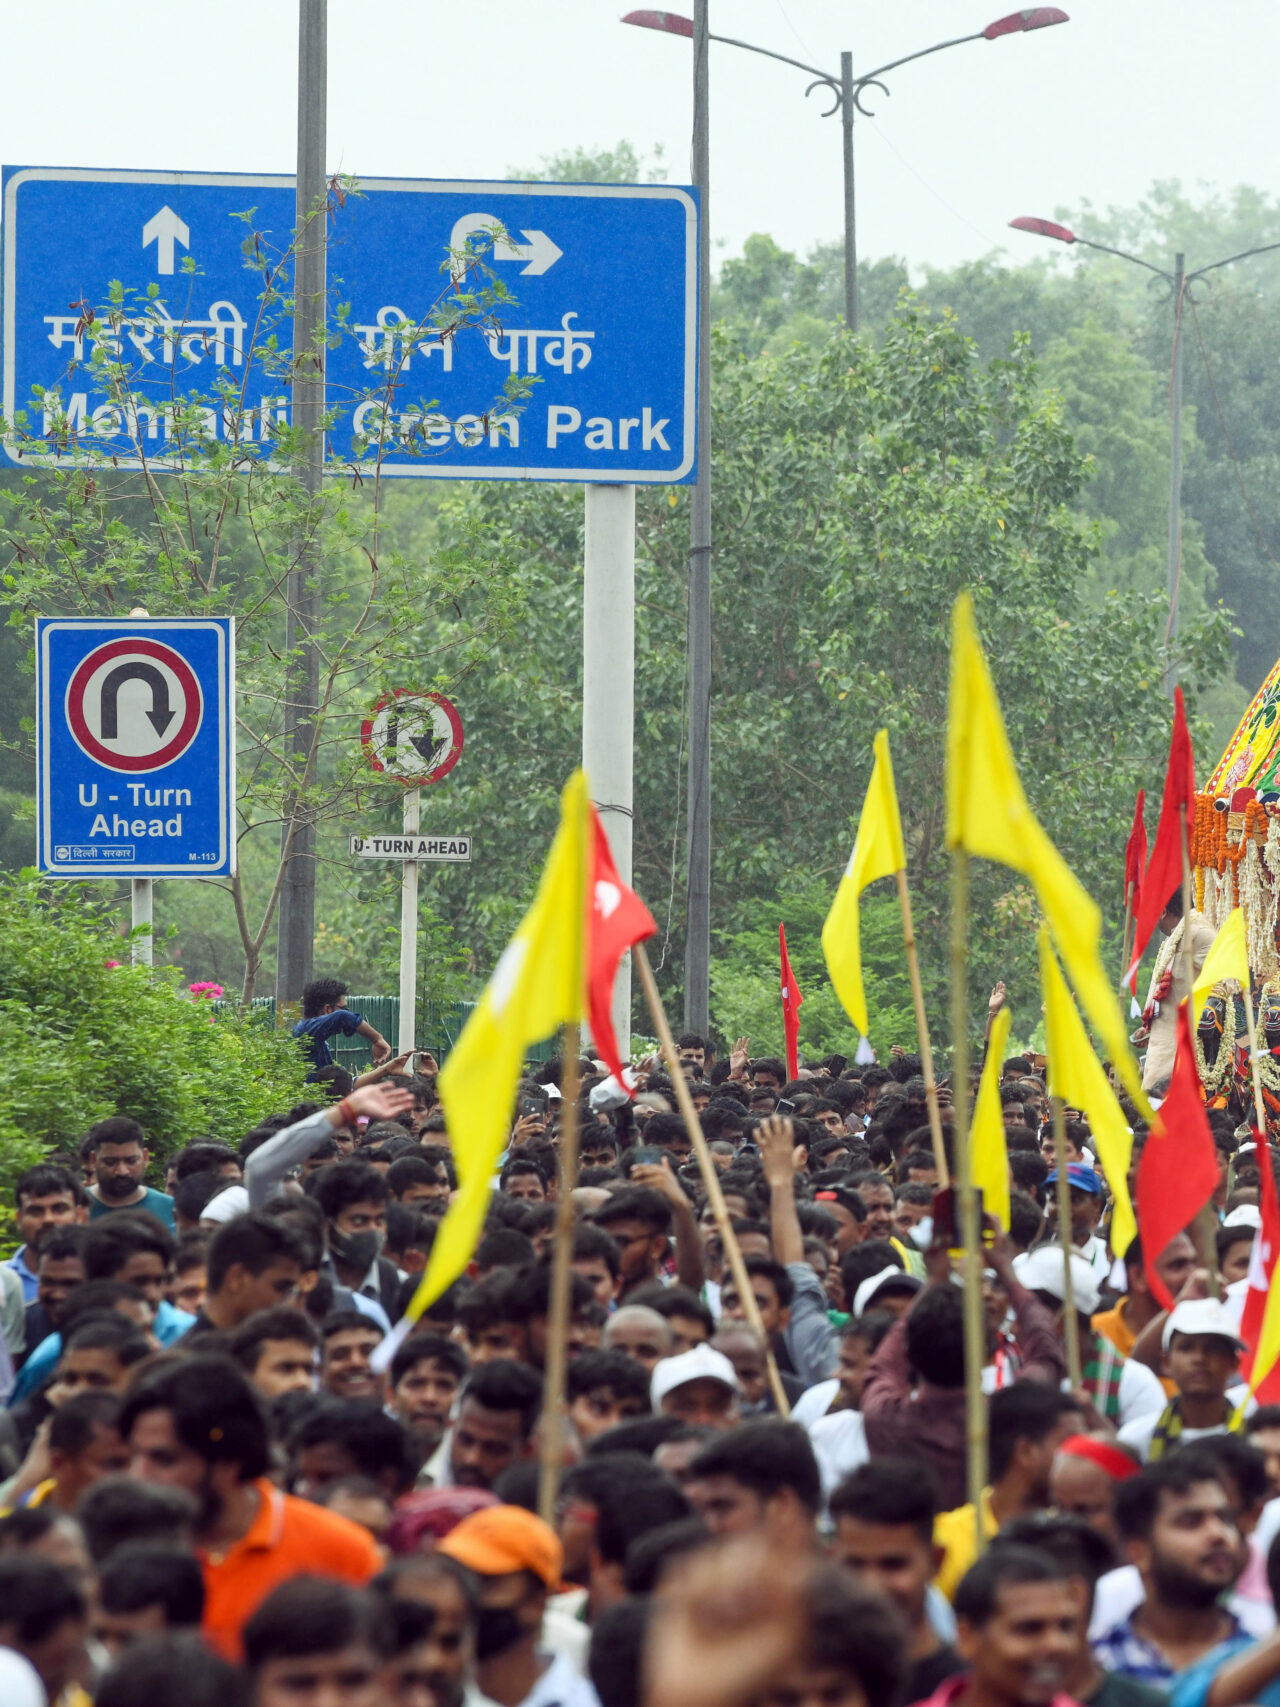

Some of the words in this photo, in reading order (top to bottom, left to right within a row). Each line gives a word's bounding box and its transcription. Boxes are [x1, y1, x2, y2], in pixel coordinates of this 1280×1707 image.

[353, 306, 457, 372] ग्रीन
[484, 311, 595, 374] पार्क
[352, 400, 520, 448] Green
[546, 405, 671, 451] Park
[78, 783, 98, 807] U
[126, 783, 192, 807] Turn
[88, 814, 183, 838] Ahead
[73, 847, 98, 858] दिल्ली
[102, 849, 131, 858] सरकार
[188, 852, 216, 861] M-113
[417, 841, 468, 855] AHEAD
